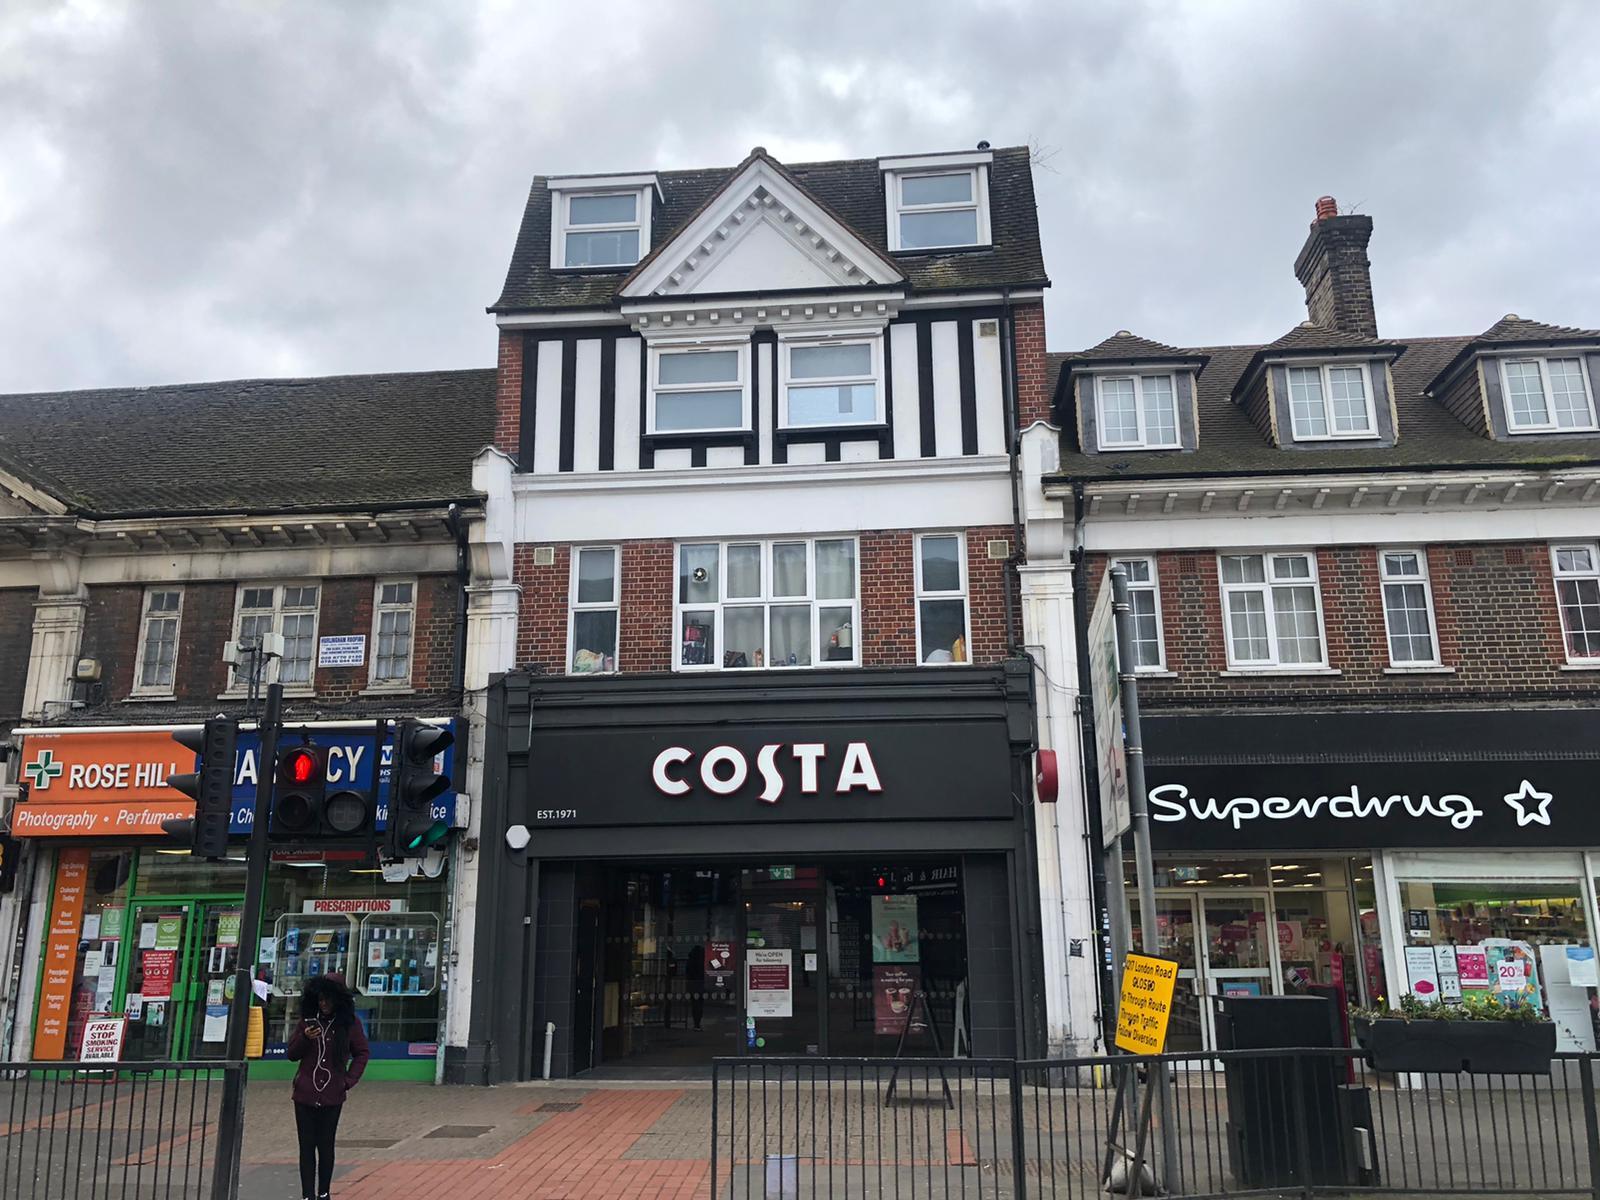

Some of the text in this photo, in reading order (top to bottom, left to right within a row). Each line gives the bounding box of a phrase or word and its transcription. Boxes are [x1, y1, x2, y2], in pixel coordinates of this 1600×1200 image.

[69, 763, 130, 788] ROSE
[652, 742, 882, 803] COSTA
[537, 810, 577, 819] EST.1971
[1149, 784, 1483, 829] Superdrug
[17, 809, 183, 830] Photography Perfumes
[314, 900, 391, 912] PRESCRIPTIONS
[1135, 961, 1154, 974] London
[1155, 965, 1173, 979] Road
[1132, 977, 1156, 991] CLOSED
[1127, 992, 1147, 1009] Through
[1148, 998, 1166, 1013] Route
[90, 1023, 118, 1031] FREE
[1121, 1008, 1159, 1029] Through Traffic
[85, 1039, 118, 1047] SMOKING
[1132, 1029, 1158, 1047] Diversion
